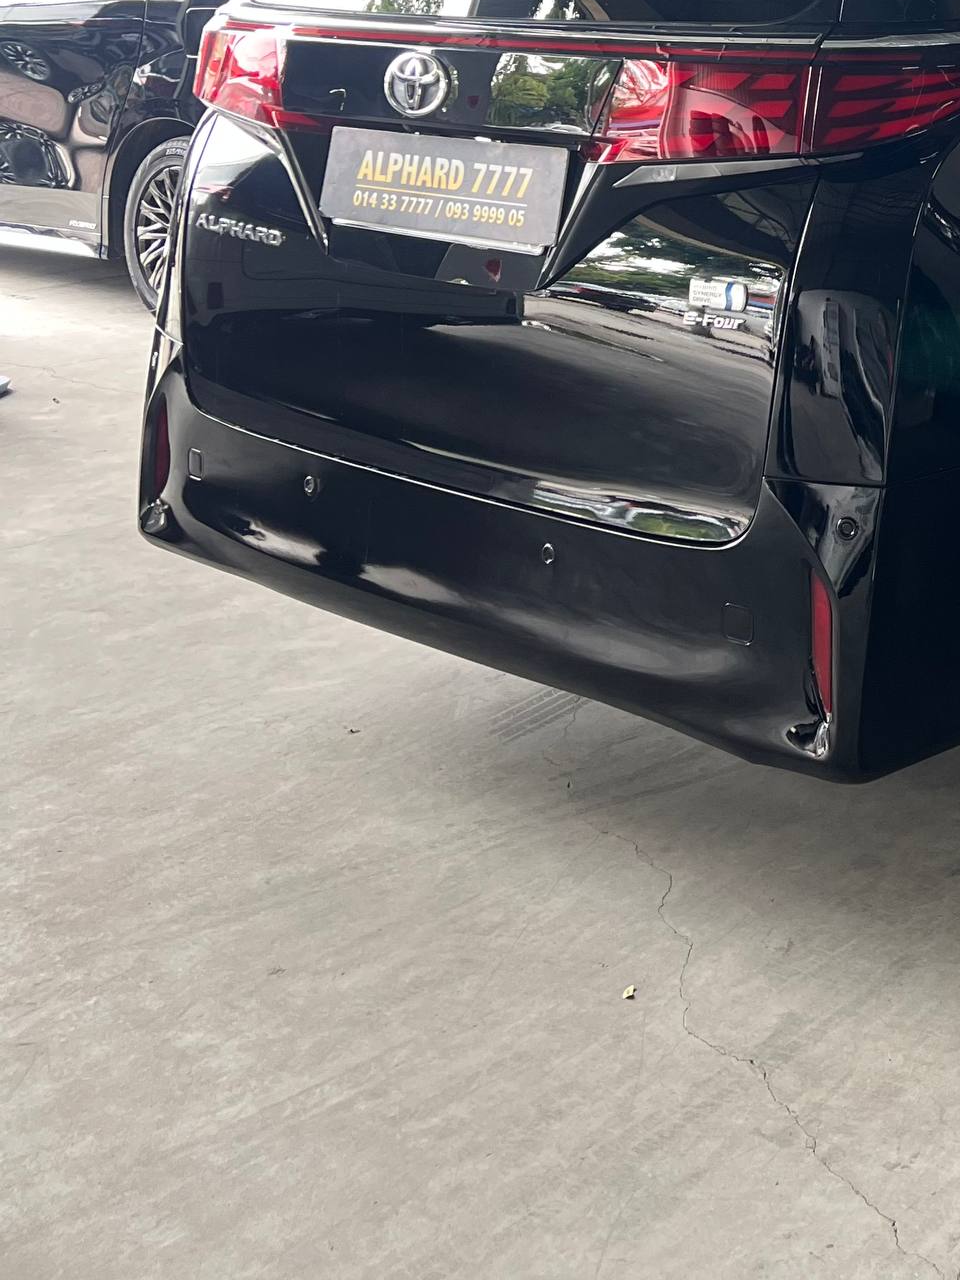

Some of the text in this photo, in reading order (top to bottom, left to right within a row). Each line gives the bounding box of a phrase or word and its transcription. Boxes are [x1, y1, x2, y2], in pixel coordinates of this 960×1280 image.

[356, 150, 533, 199] ALPHARD 7777
[353, 190, 526, 228] 014 33 7777 / 093 9999 05
[195, 213, 282, 246] ALPHARD
[683, 311, 745, 329] E-Four
